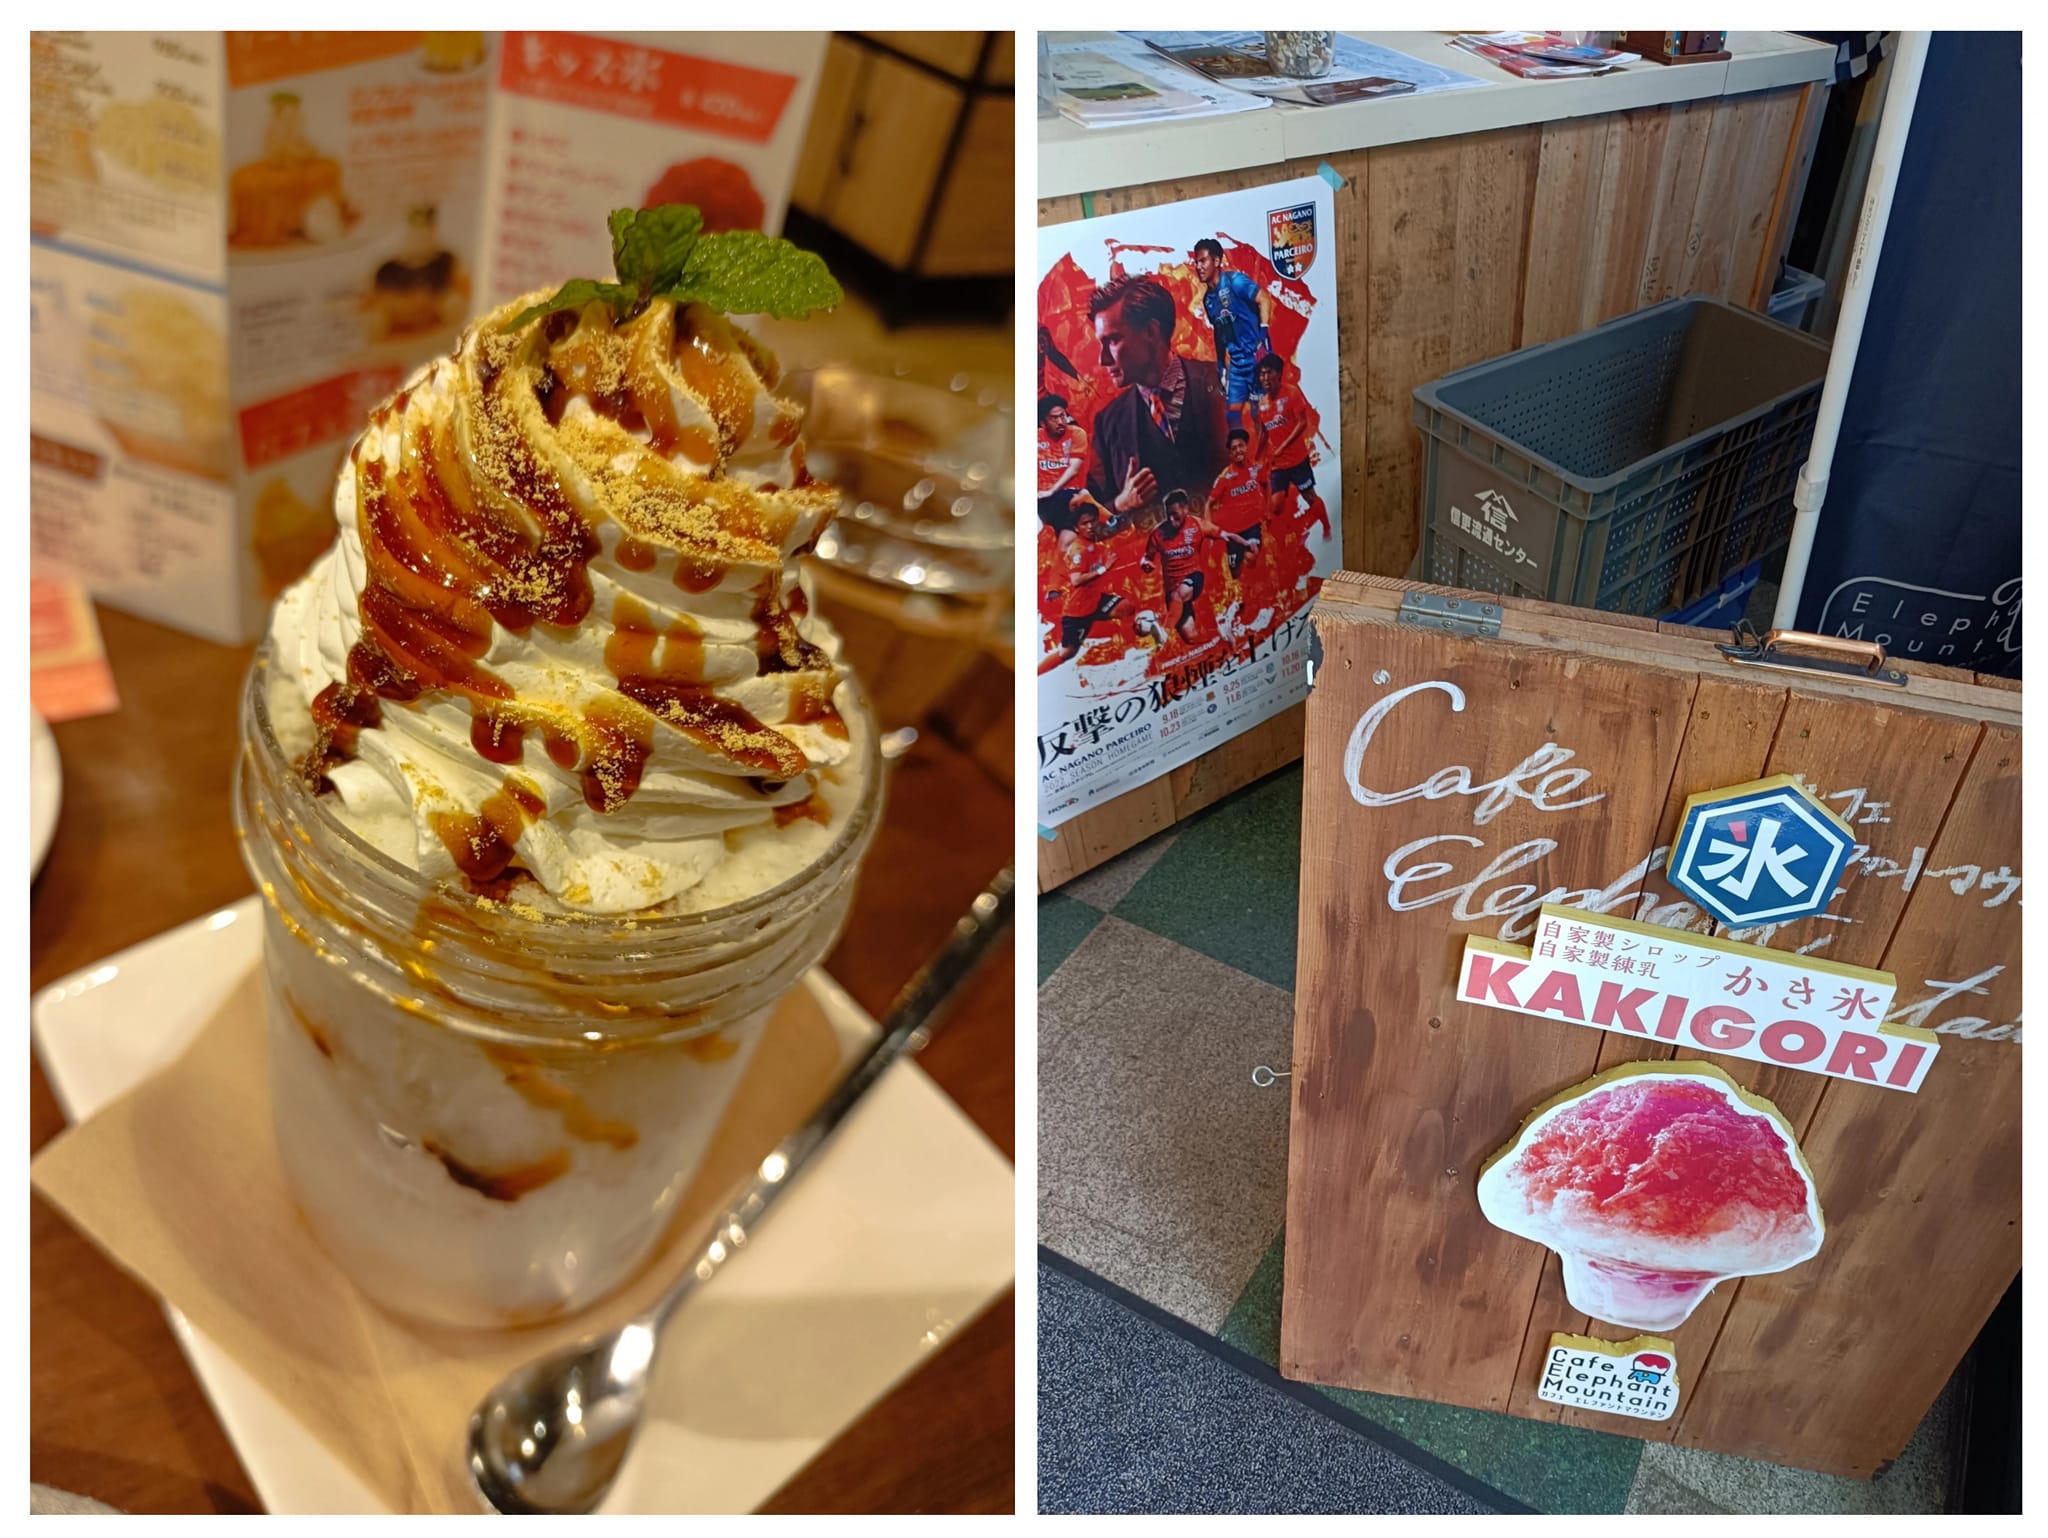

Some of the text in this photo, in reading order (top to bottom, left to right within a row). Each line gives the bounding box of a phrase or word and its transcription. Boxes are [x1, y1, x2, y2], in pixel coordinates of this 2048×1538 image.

[1271, 208, 1313, 225] AC NAGANO
[1273, 244, 1313, 261] PARCEIRO
[1042, 770, 1057, 783] AC
[1059, 746, 1104, 773] NAGANO
[1106, 723, 1152, 751] PARCEIRO
[1344, 680, 1606, 826] Cafe
[1698, 818, 1808, 900] 氷
[1543, 920, 1721, 970] 自家製シロップ
[1539, 939, 1880, 1020] 自家製練乳 かき氷
[1465, 955, 1927, 1088] KAKIGORI
[1548, 1362, 1672, 1397] Elephant
[1552, 1349, 1614, 1372] Cafe
[1541, 1390, 1564, 1400] カフェ
[1543, 1376, 1667, 1411] Mountain
